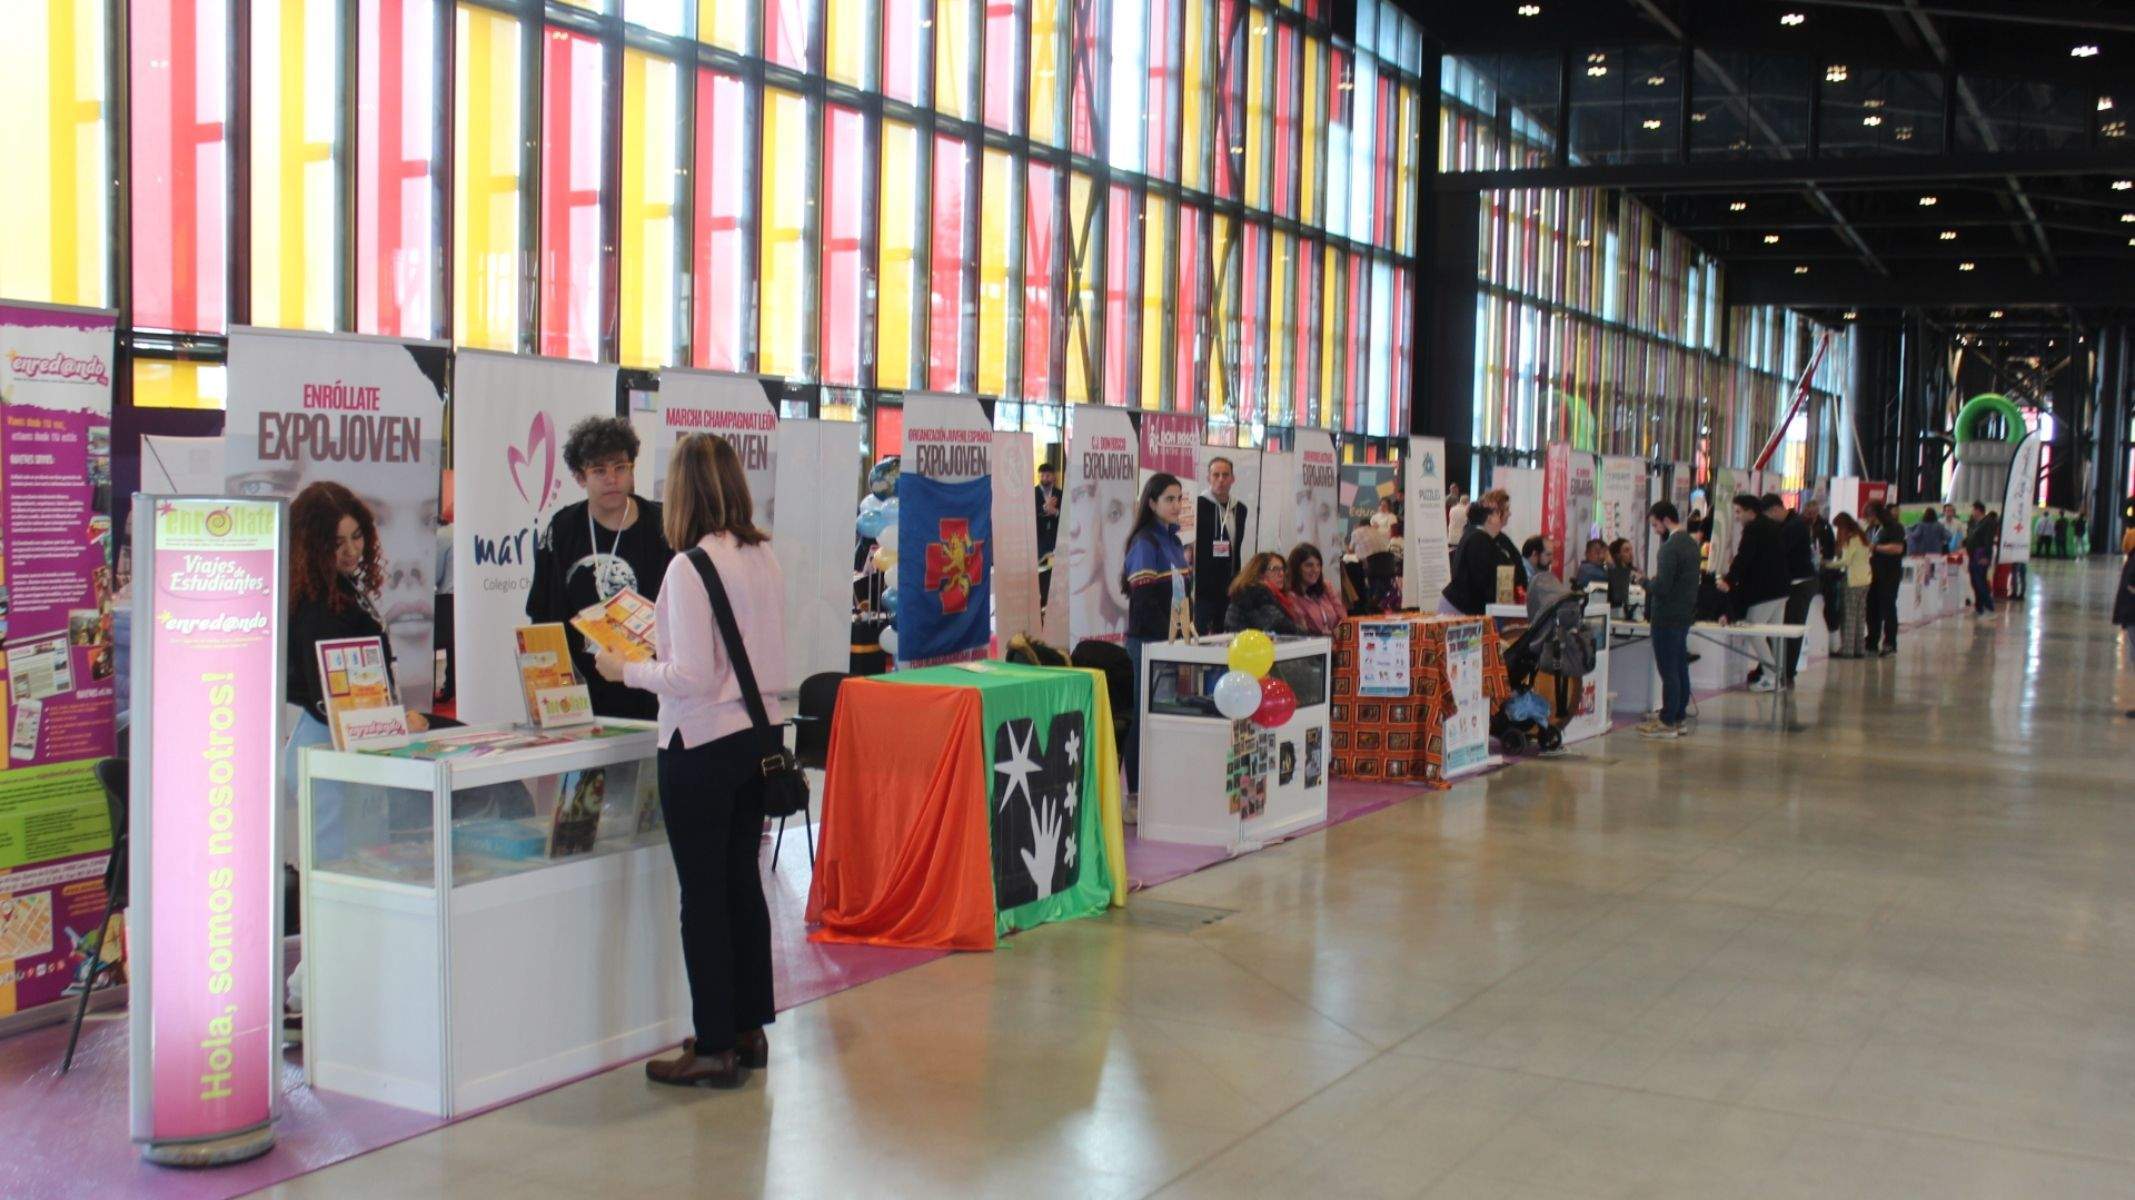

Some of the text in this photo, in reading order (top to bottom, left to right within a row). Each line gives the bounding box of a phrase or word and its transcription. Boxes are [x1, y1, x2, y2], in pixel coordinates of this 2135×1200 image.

[303, 379, 380, 411] ENRÓLLATE
[665, 408, 776, 431] MARCHA CHAMPAGNAT LEÓN
[258, 411, 421, 463] EXPOJOVEN
[908, 427, 992, 443] ORGANIZACIÓN JUVENIL ESPAÑOLA
[916, 444, 986, 476] EXPOJOVEN
[1083, 453, 1134, 480] EXPOJOVEN
[1303, 464, 1335, 487] EXPOJOVEN
[474, 517, 541, 566] mari
[183, 554, 246, 578] Viajes de
[169, 571, 264, 595] Estudiantes
[483, 577, 532, 593] Colegio Ch
[165, 611, 268, 634] enred@ndo
[200, 671, 238, 1100] Hola, somos nosotros!
